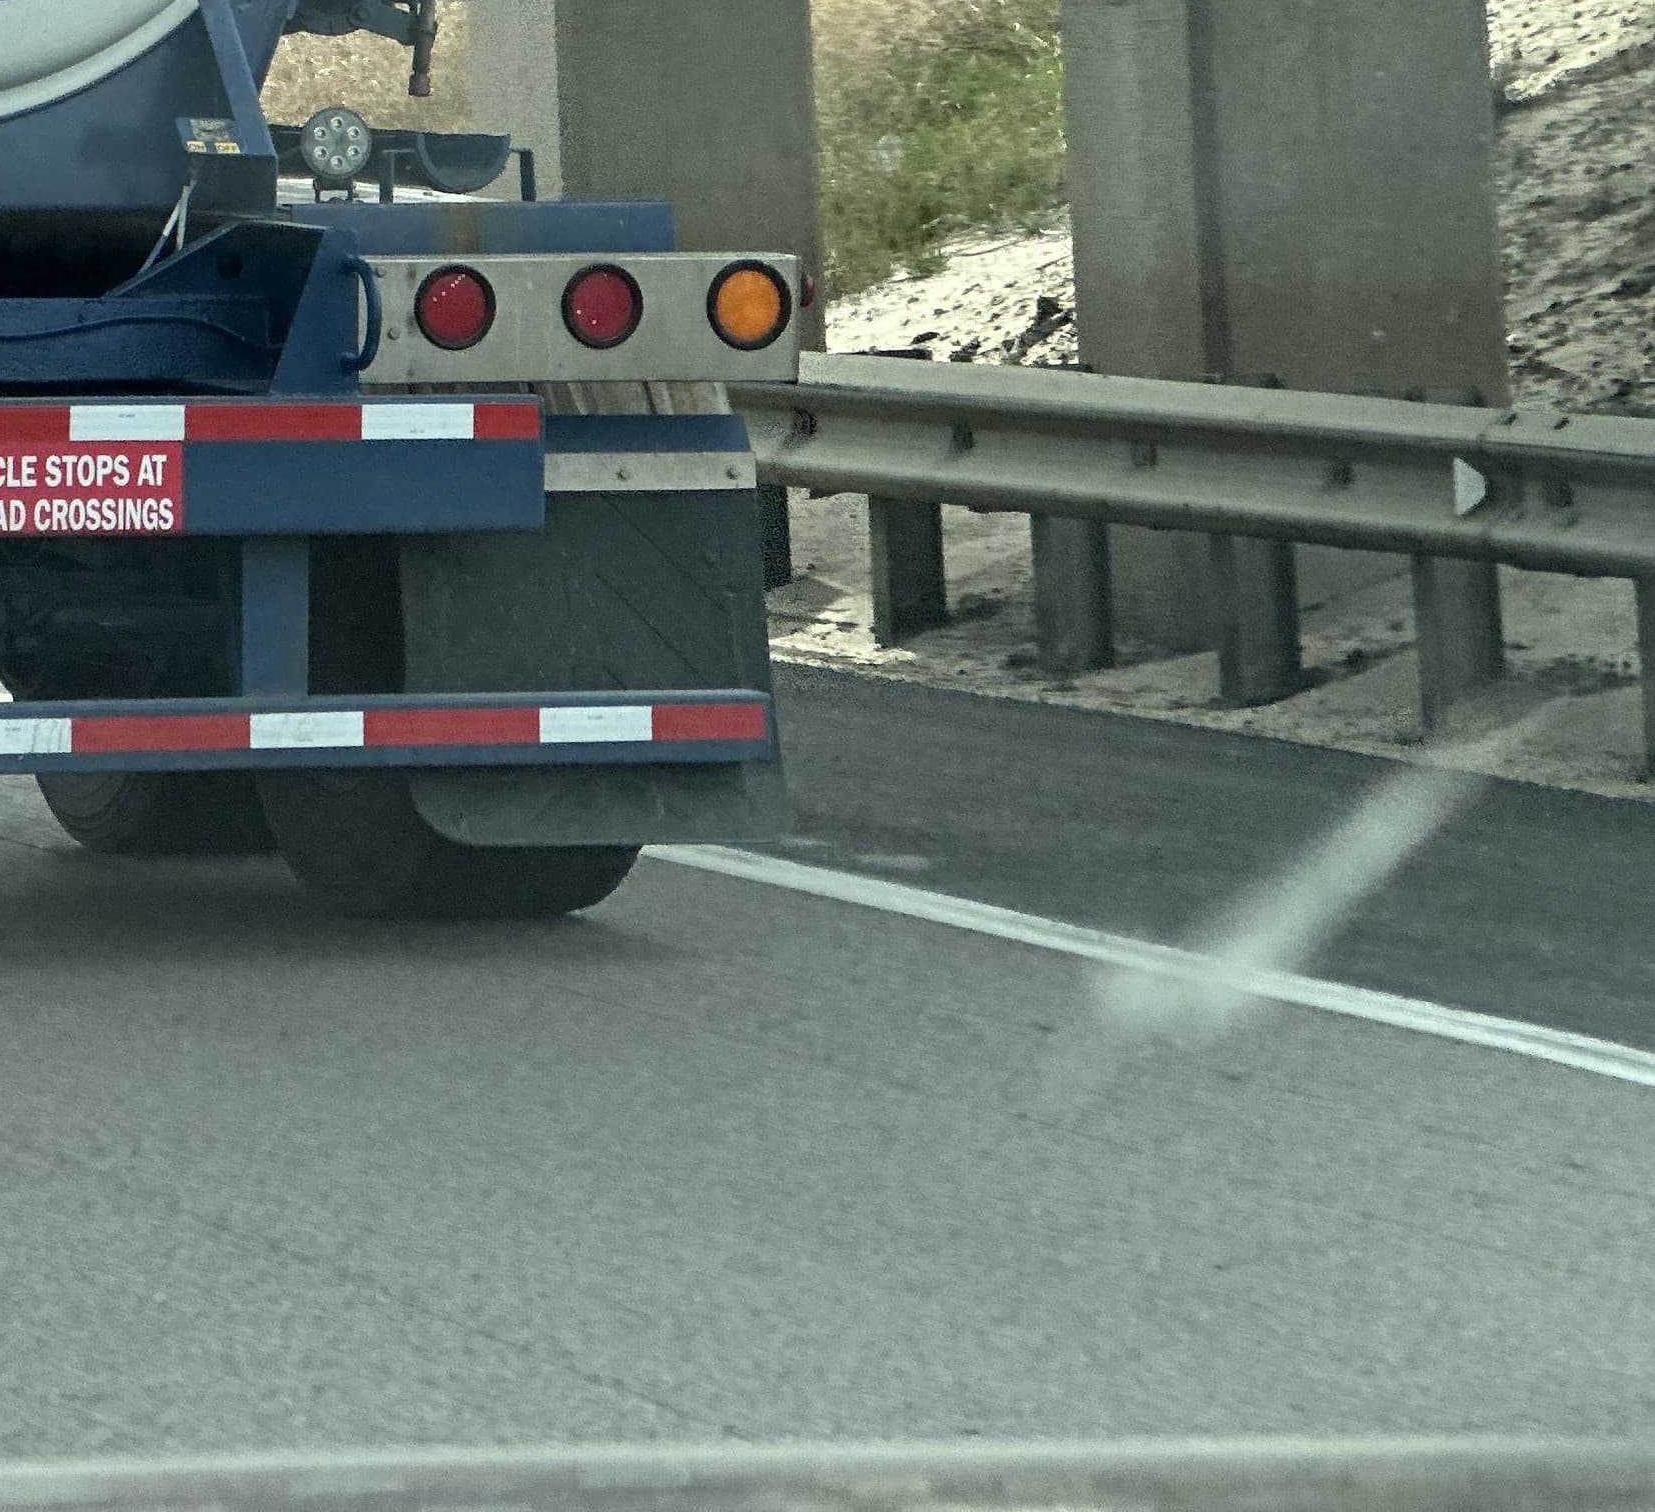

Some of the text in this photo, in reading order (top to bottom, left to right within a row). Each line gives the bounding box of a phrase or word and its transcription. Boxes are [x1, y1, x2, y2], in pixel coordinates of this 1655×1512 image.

[45, 454, 130, 488] STOPS
[137, 454, 168, 487] AT
[33, 498, 174, 531] CROSSINGS
